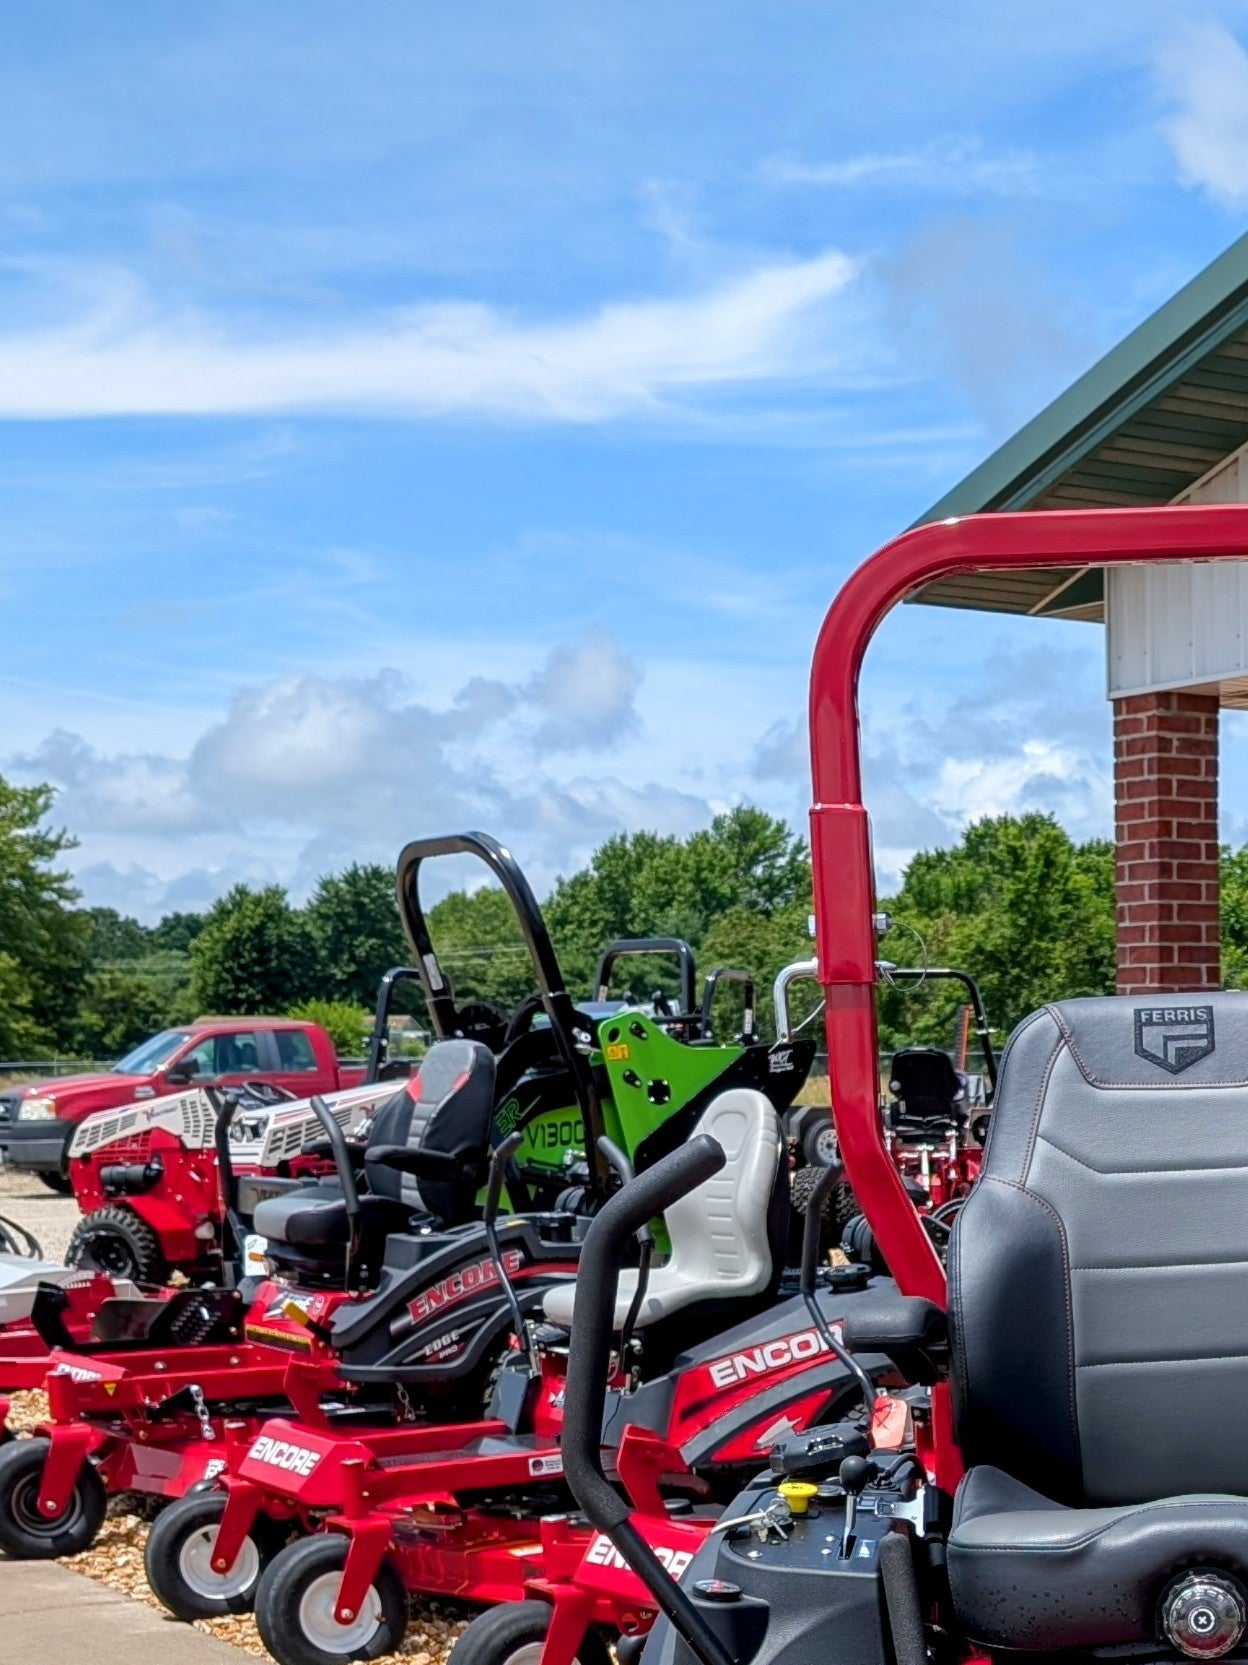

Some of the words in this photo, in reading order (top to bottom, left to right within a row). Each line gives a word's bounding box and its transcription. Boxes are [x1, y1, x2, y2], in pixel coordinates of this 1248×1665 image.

[1140, 1008, 1208, 1023] FERRIS
[425, 1329, 460, 1356] EDGE
[709, 1324, 844, 1388] ENCOR
[249, 1436, 321, 1477] ENCORE
